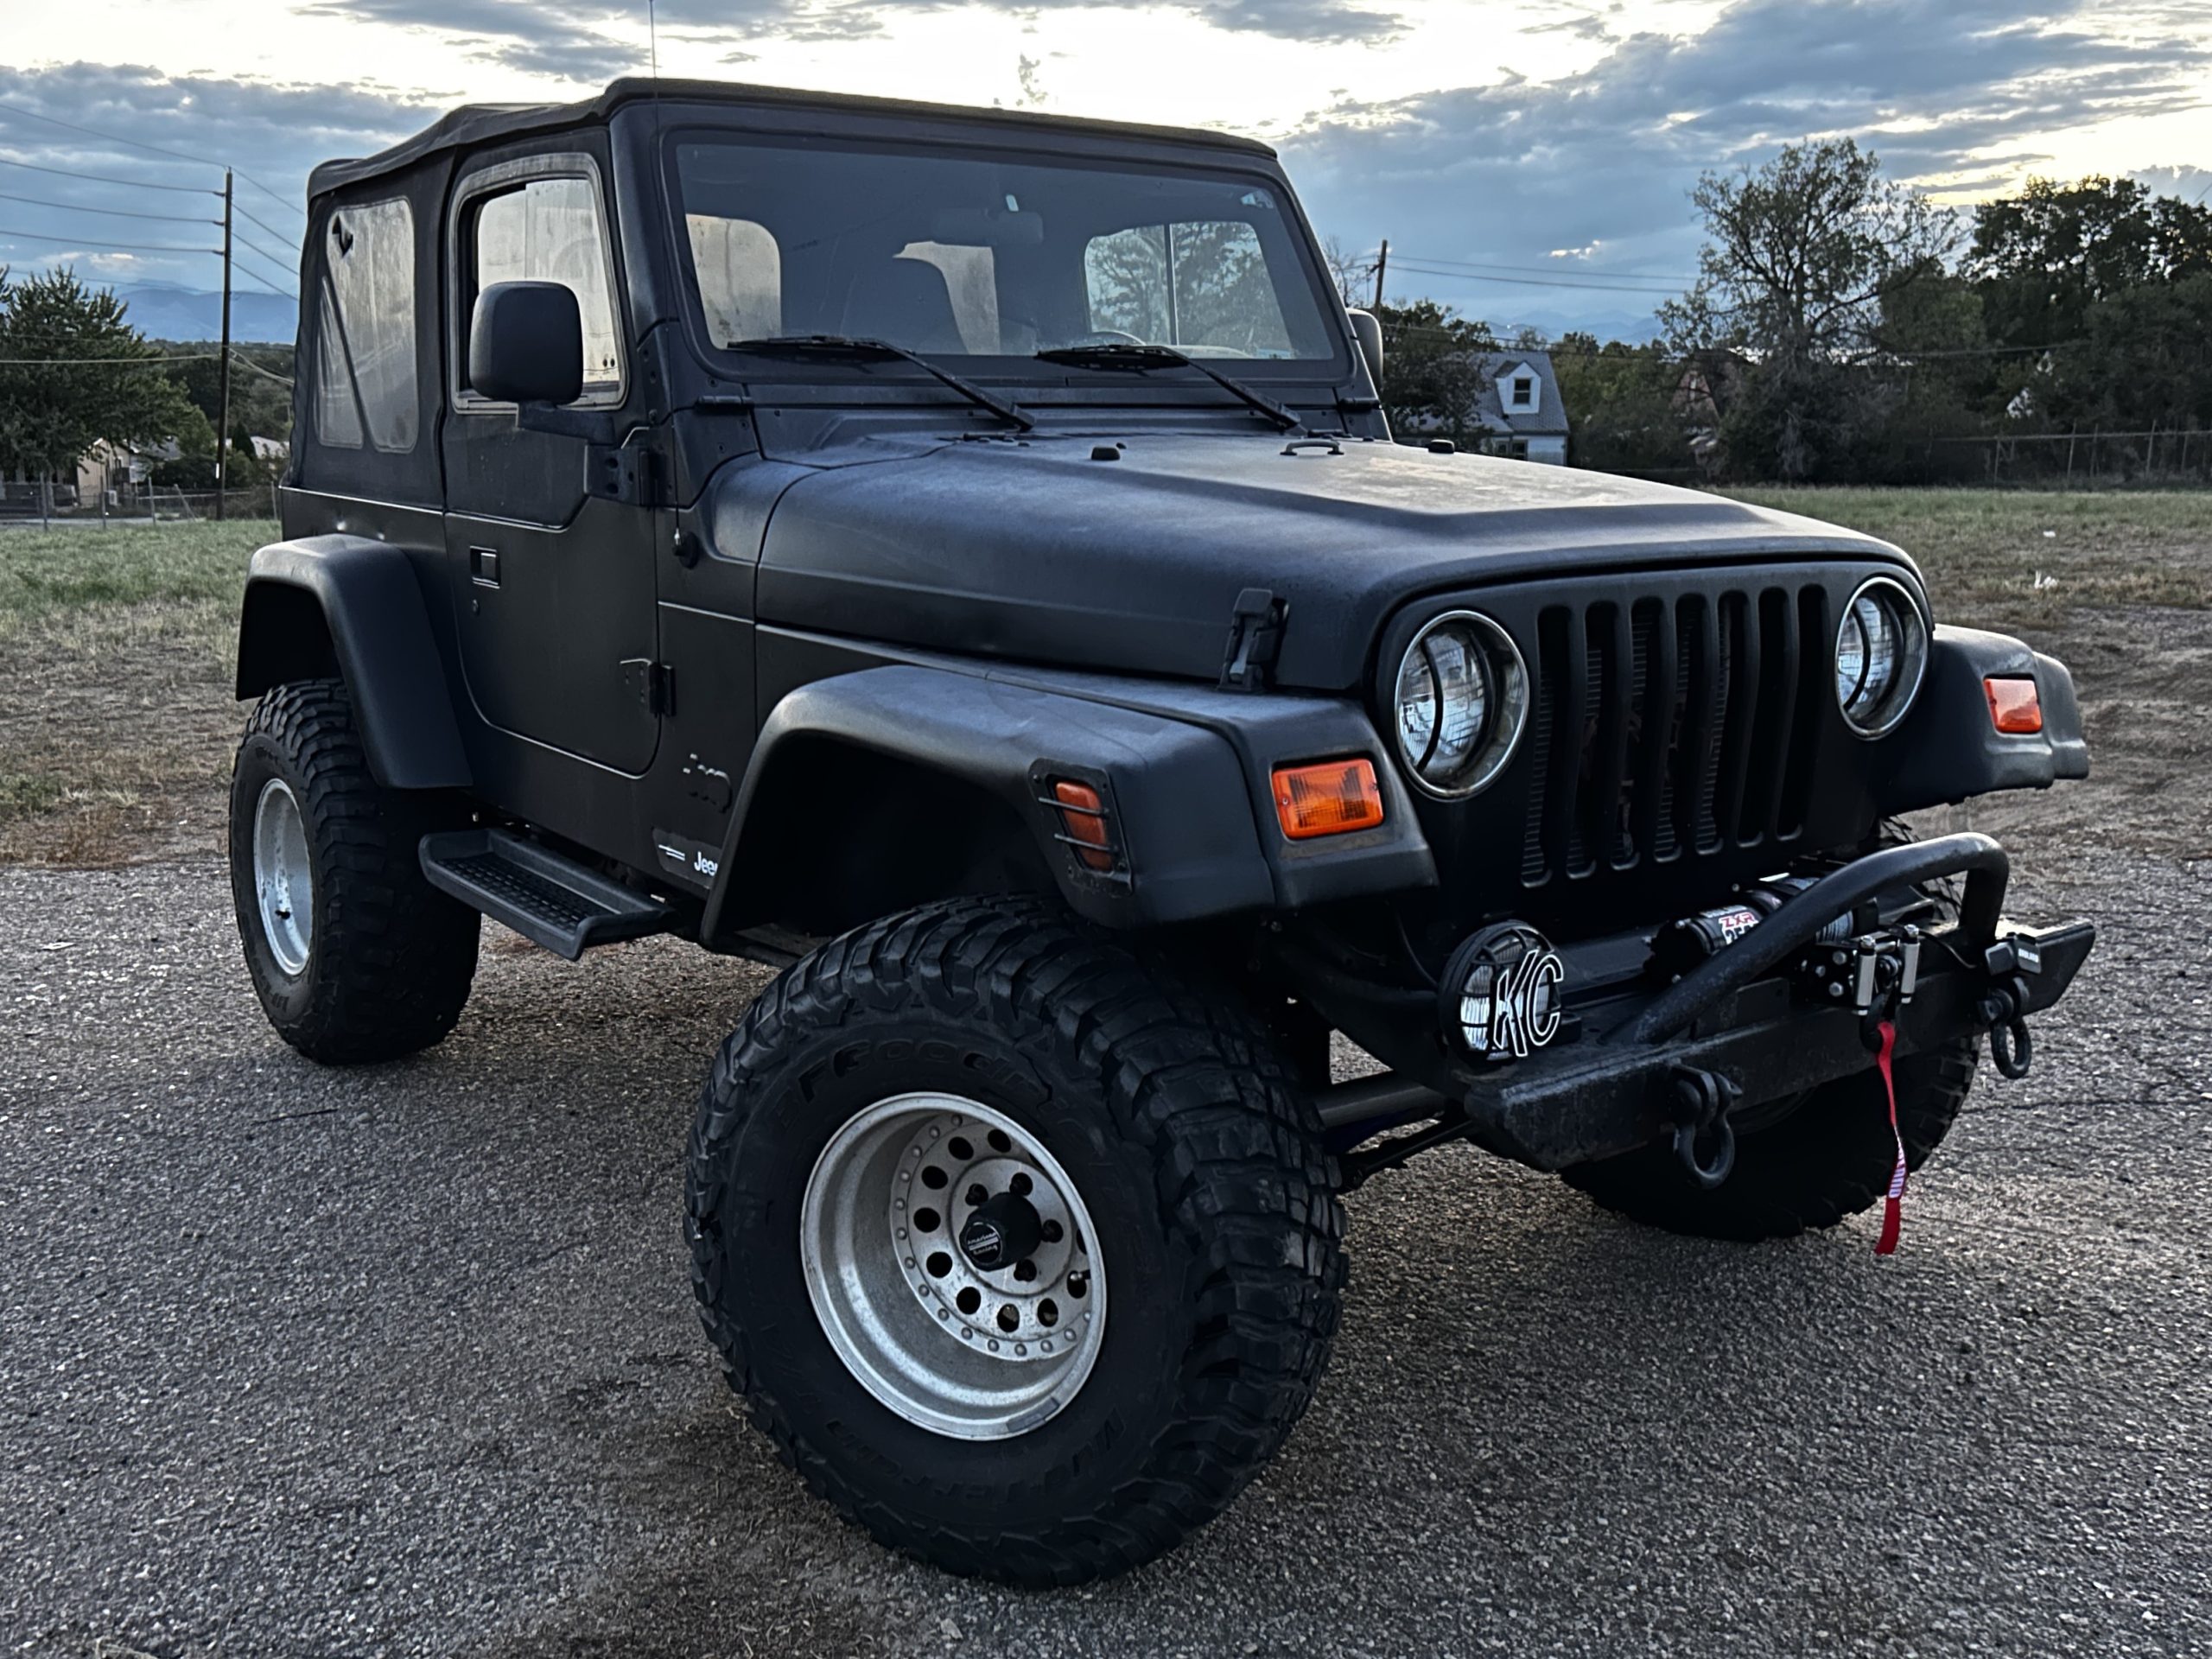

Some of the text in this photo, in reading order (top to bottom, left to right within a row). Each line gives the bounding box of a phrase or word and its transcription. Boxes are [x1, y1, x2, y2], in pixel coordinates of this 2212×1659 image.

[694, 851, 718, 876] Jee
[1719, 912, 1757, 928] ZXR
[1493, 950, 1564, 1057] KC
